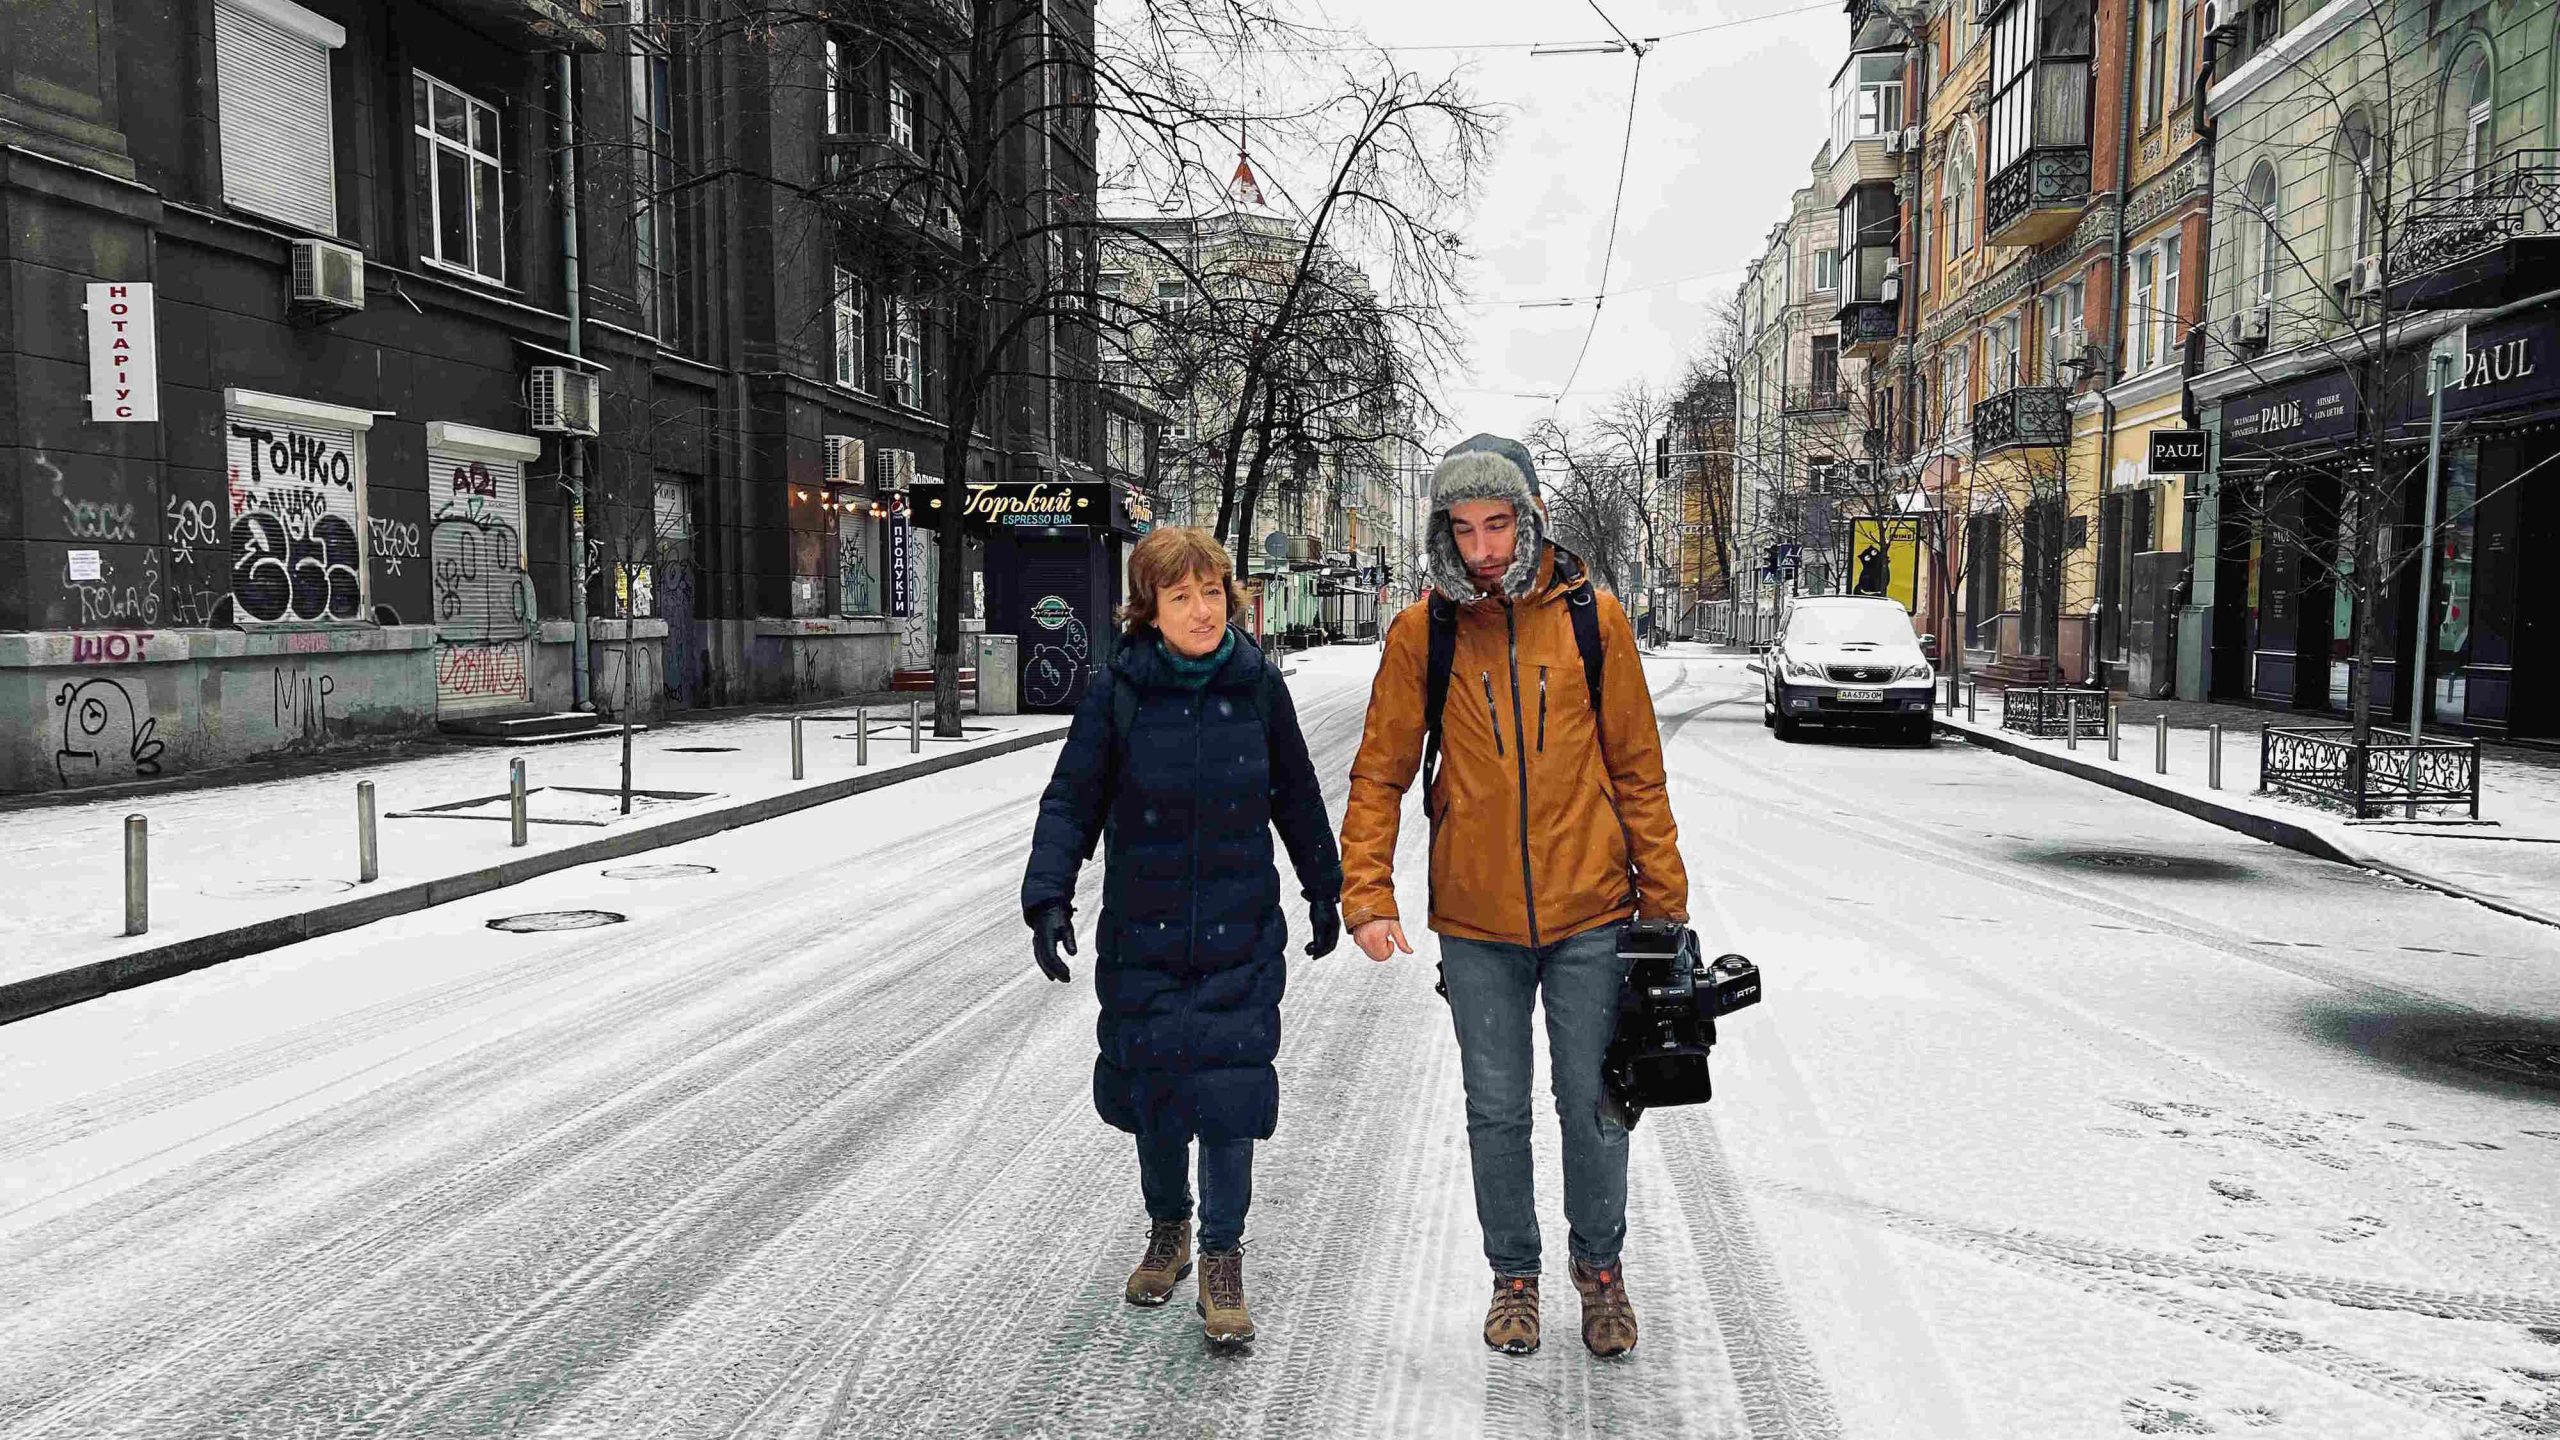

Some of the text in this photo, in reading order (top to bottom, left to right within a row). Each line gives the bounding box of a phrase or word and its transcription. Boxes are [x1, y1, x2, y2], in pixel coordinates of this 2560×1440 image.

[2459, 338, 2535, 391] PAUL
[2261, 399, 2303, 434] PAUL
[2155, 444, 2203, 458] PAUL
[963, 483, 1073, 524] Горький
[1002, 513, 1073, 525] ESPRESSO BAR
[894, 526, 904, 611] ПРОДУКТИ
[1736, 985, 1757, 999] RTP
